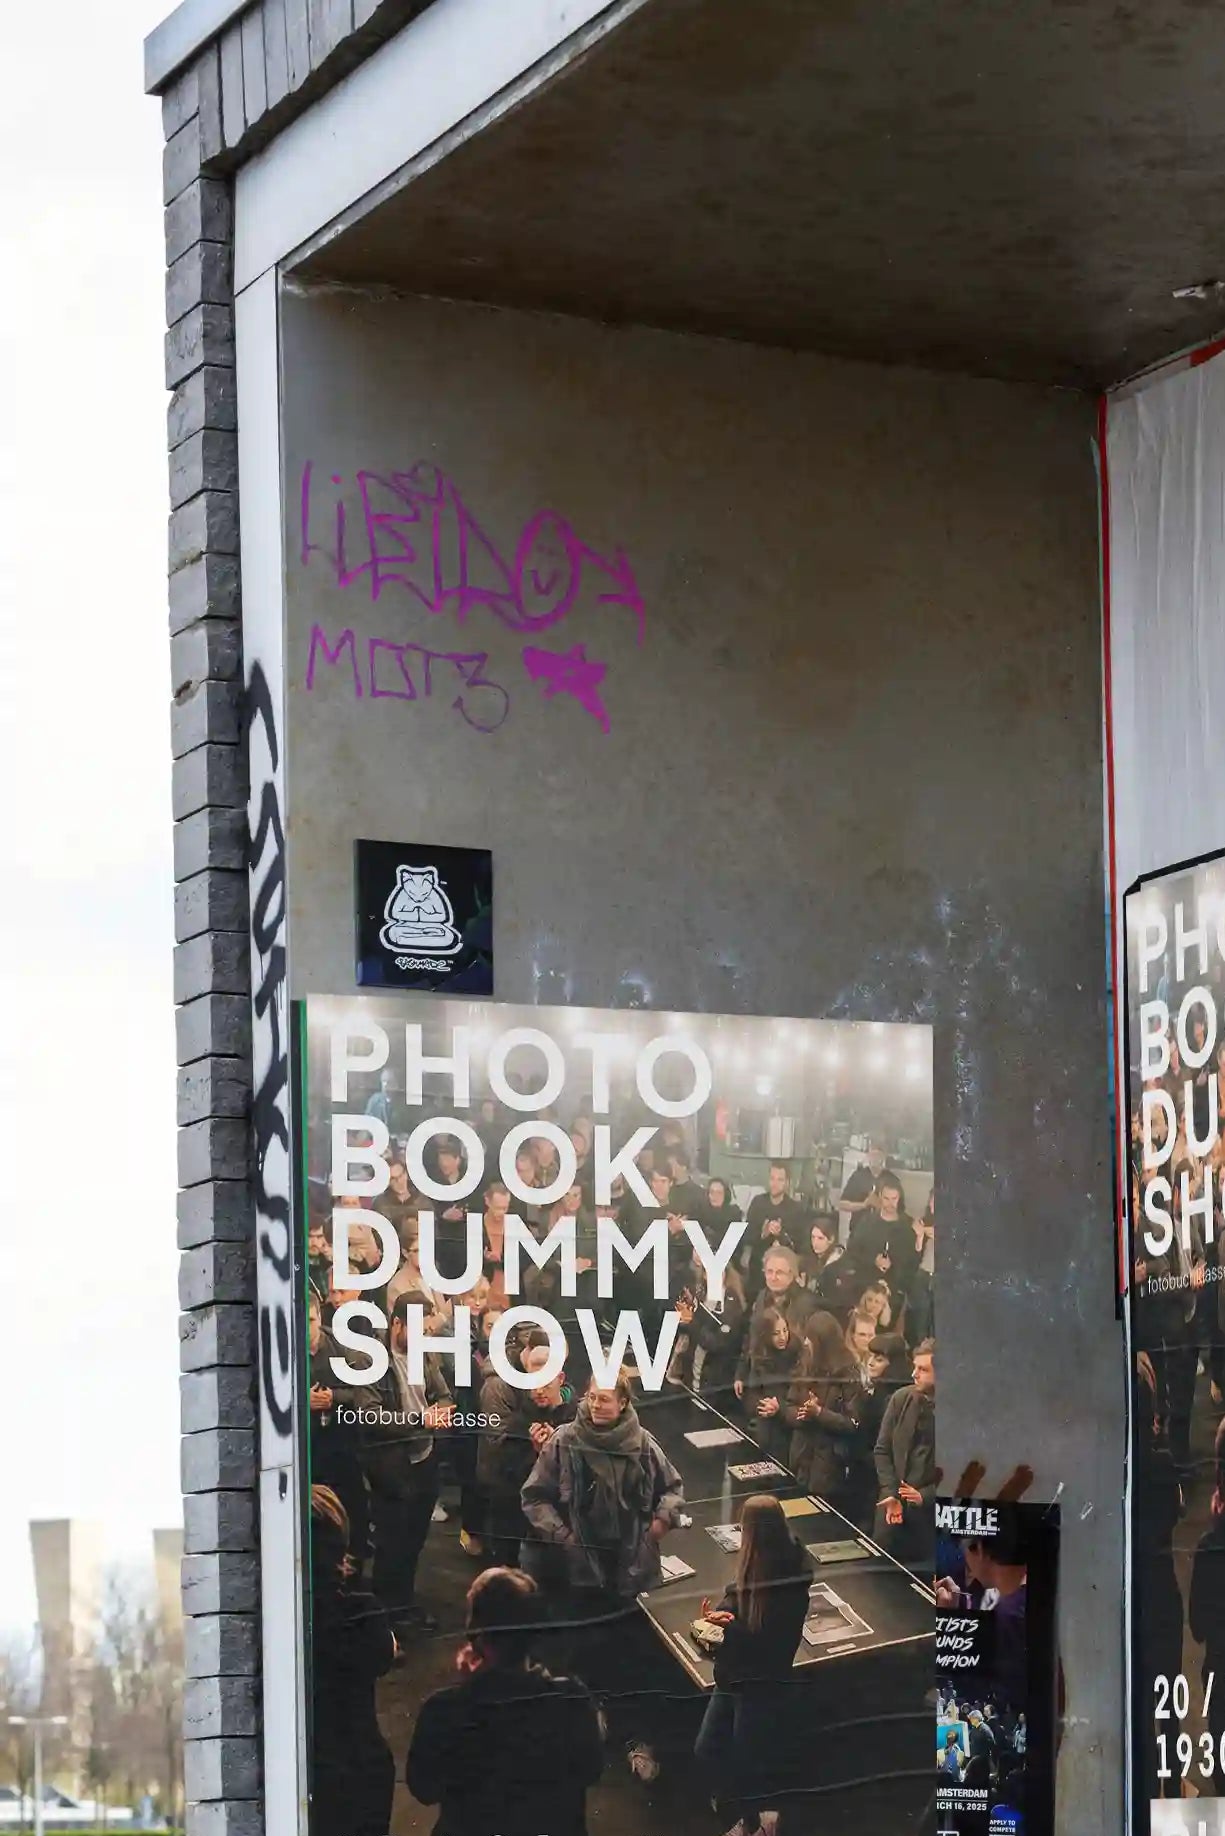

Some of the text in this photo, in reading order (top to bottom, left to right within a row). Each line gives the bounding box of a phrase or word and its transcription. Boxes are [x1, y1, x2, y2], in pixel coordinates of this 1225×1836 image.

[330, 1020, 712, 1117] PHOTO
[331, 1113, 661, 1208] BOOK
[331, 1208, 749, 1301] DUMMY
[328, 1300, 682, 1391] SHOW
[335, 1405, 501, 1427] fotobuchklasse
[1154, 1674, 1189, 1719] 20
[1201, 1671, 1215, 1717] /
[966, 1803, 987, 1811] 2025
